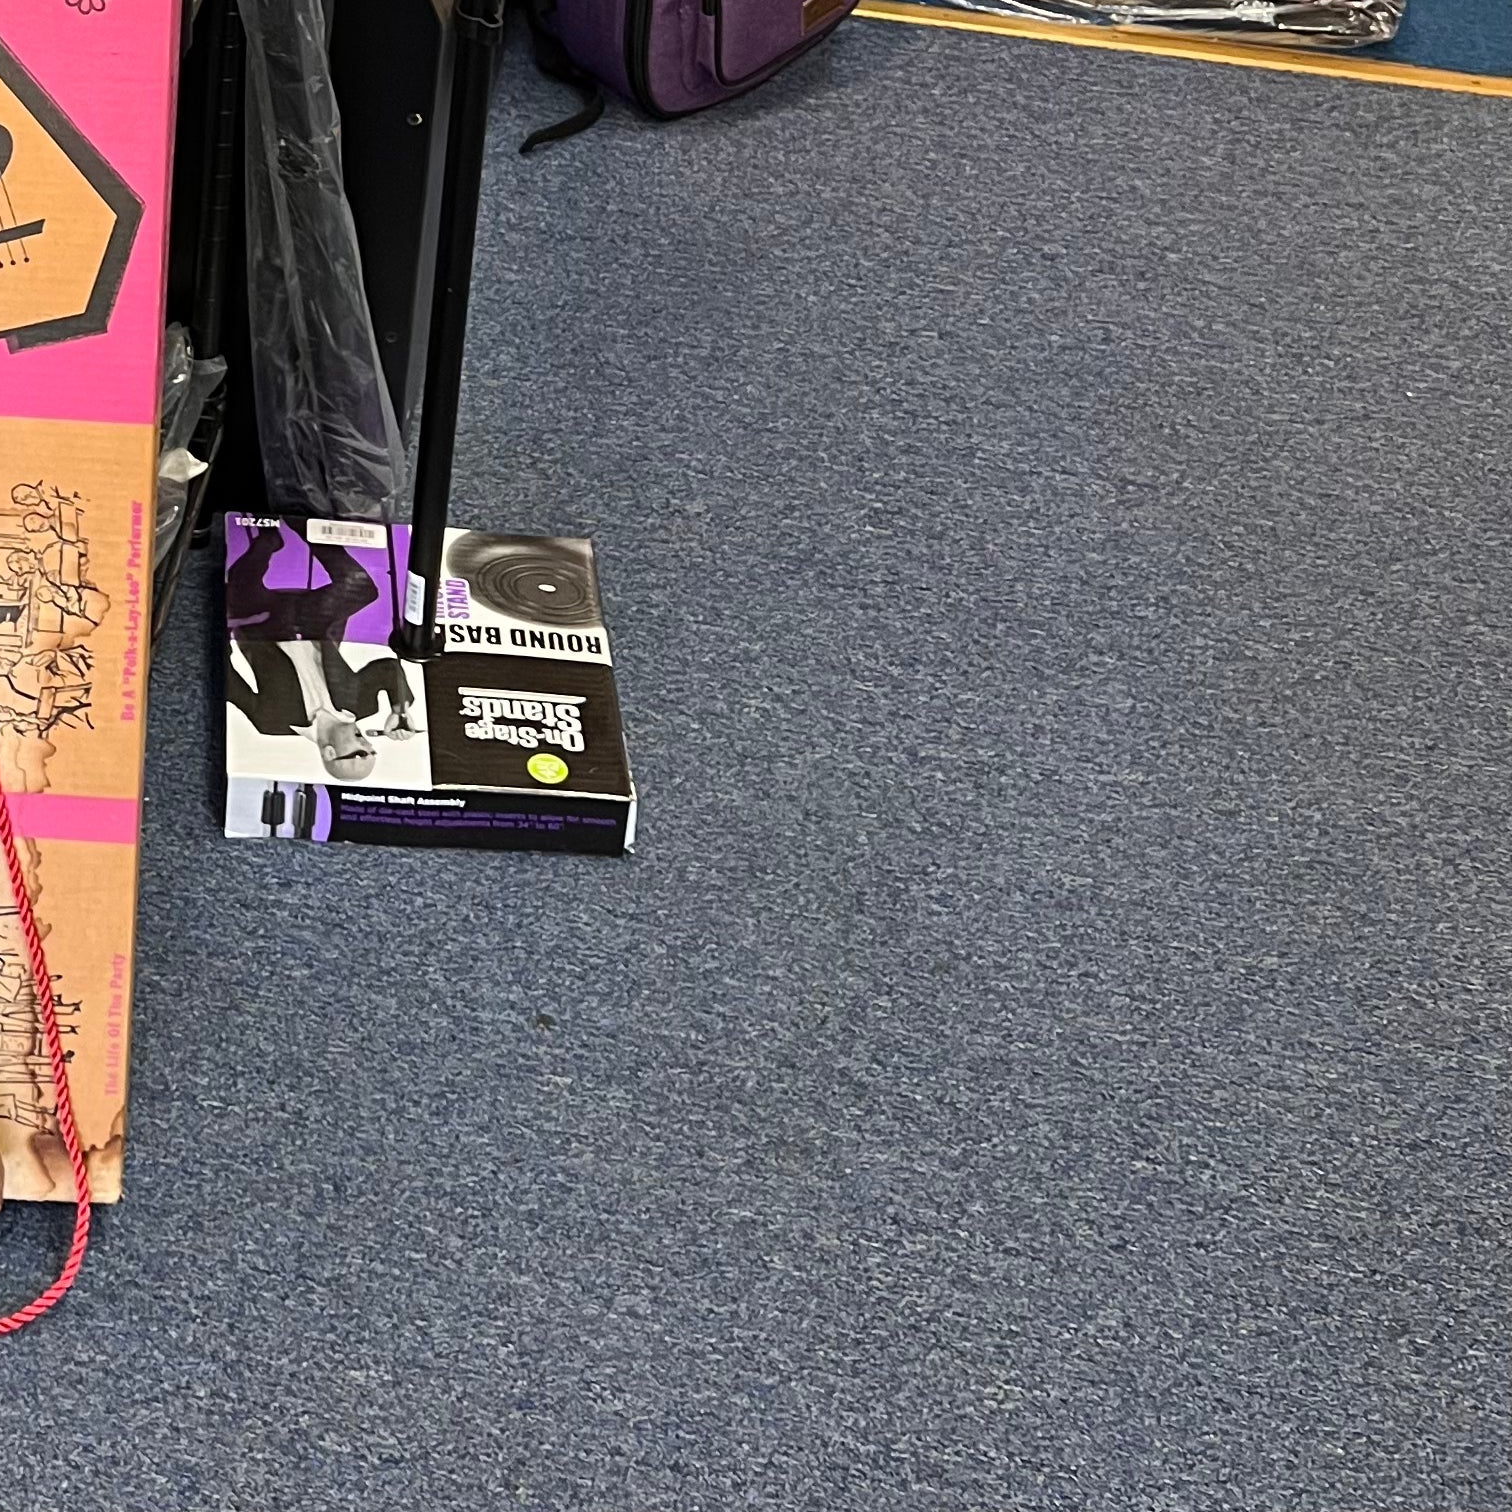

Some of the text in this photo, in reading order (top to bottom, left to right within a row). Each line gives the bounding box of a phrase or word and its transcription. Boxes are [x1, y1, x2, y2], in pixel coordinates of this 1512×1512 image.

[126, 499, 145, 569] Performer
[234, 517, 281, 529] MS7201
[445, 579, 470, 619] STAND
[510, 628, 602, 655] ROUND
[122, 689, 136, 701] A
[120, 703, 136, 721] Be
[459, 696, 583, 732] Stands
[464, 720, 585, 753] On-Stage
[341, 791, 467, 808] Midpoint Shaft Assembly
[104, 952, 127, 1098] The Life Of The Party
